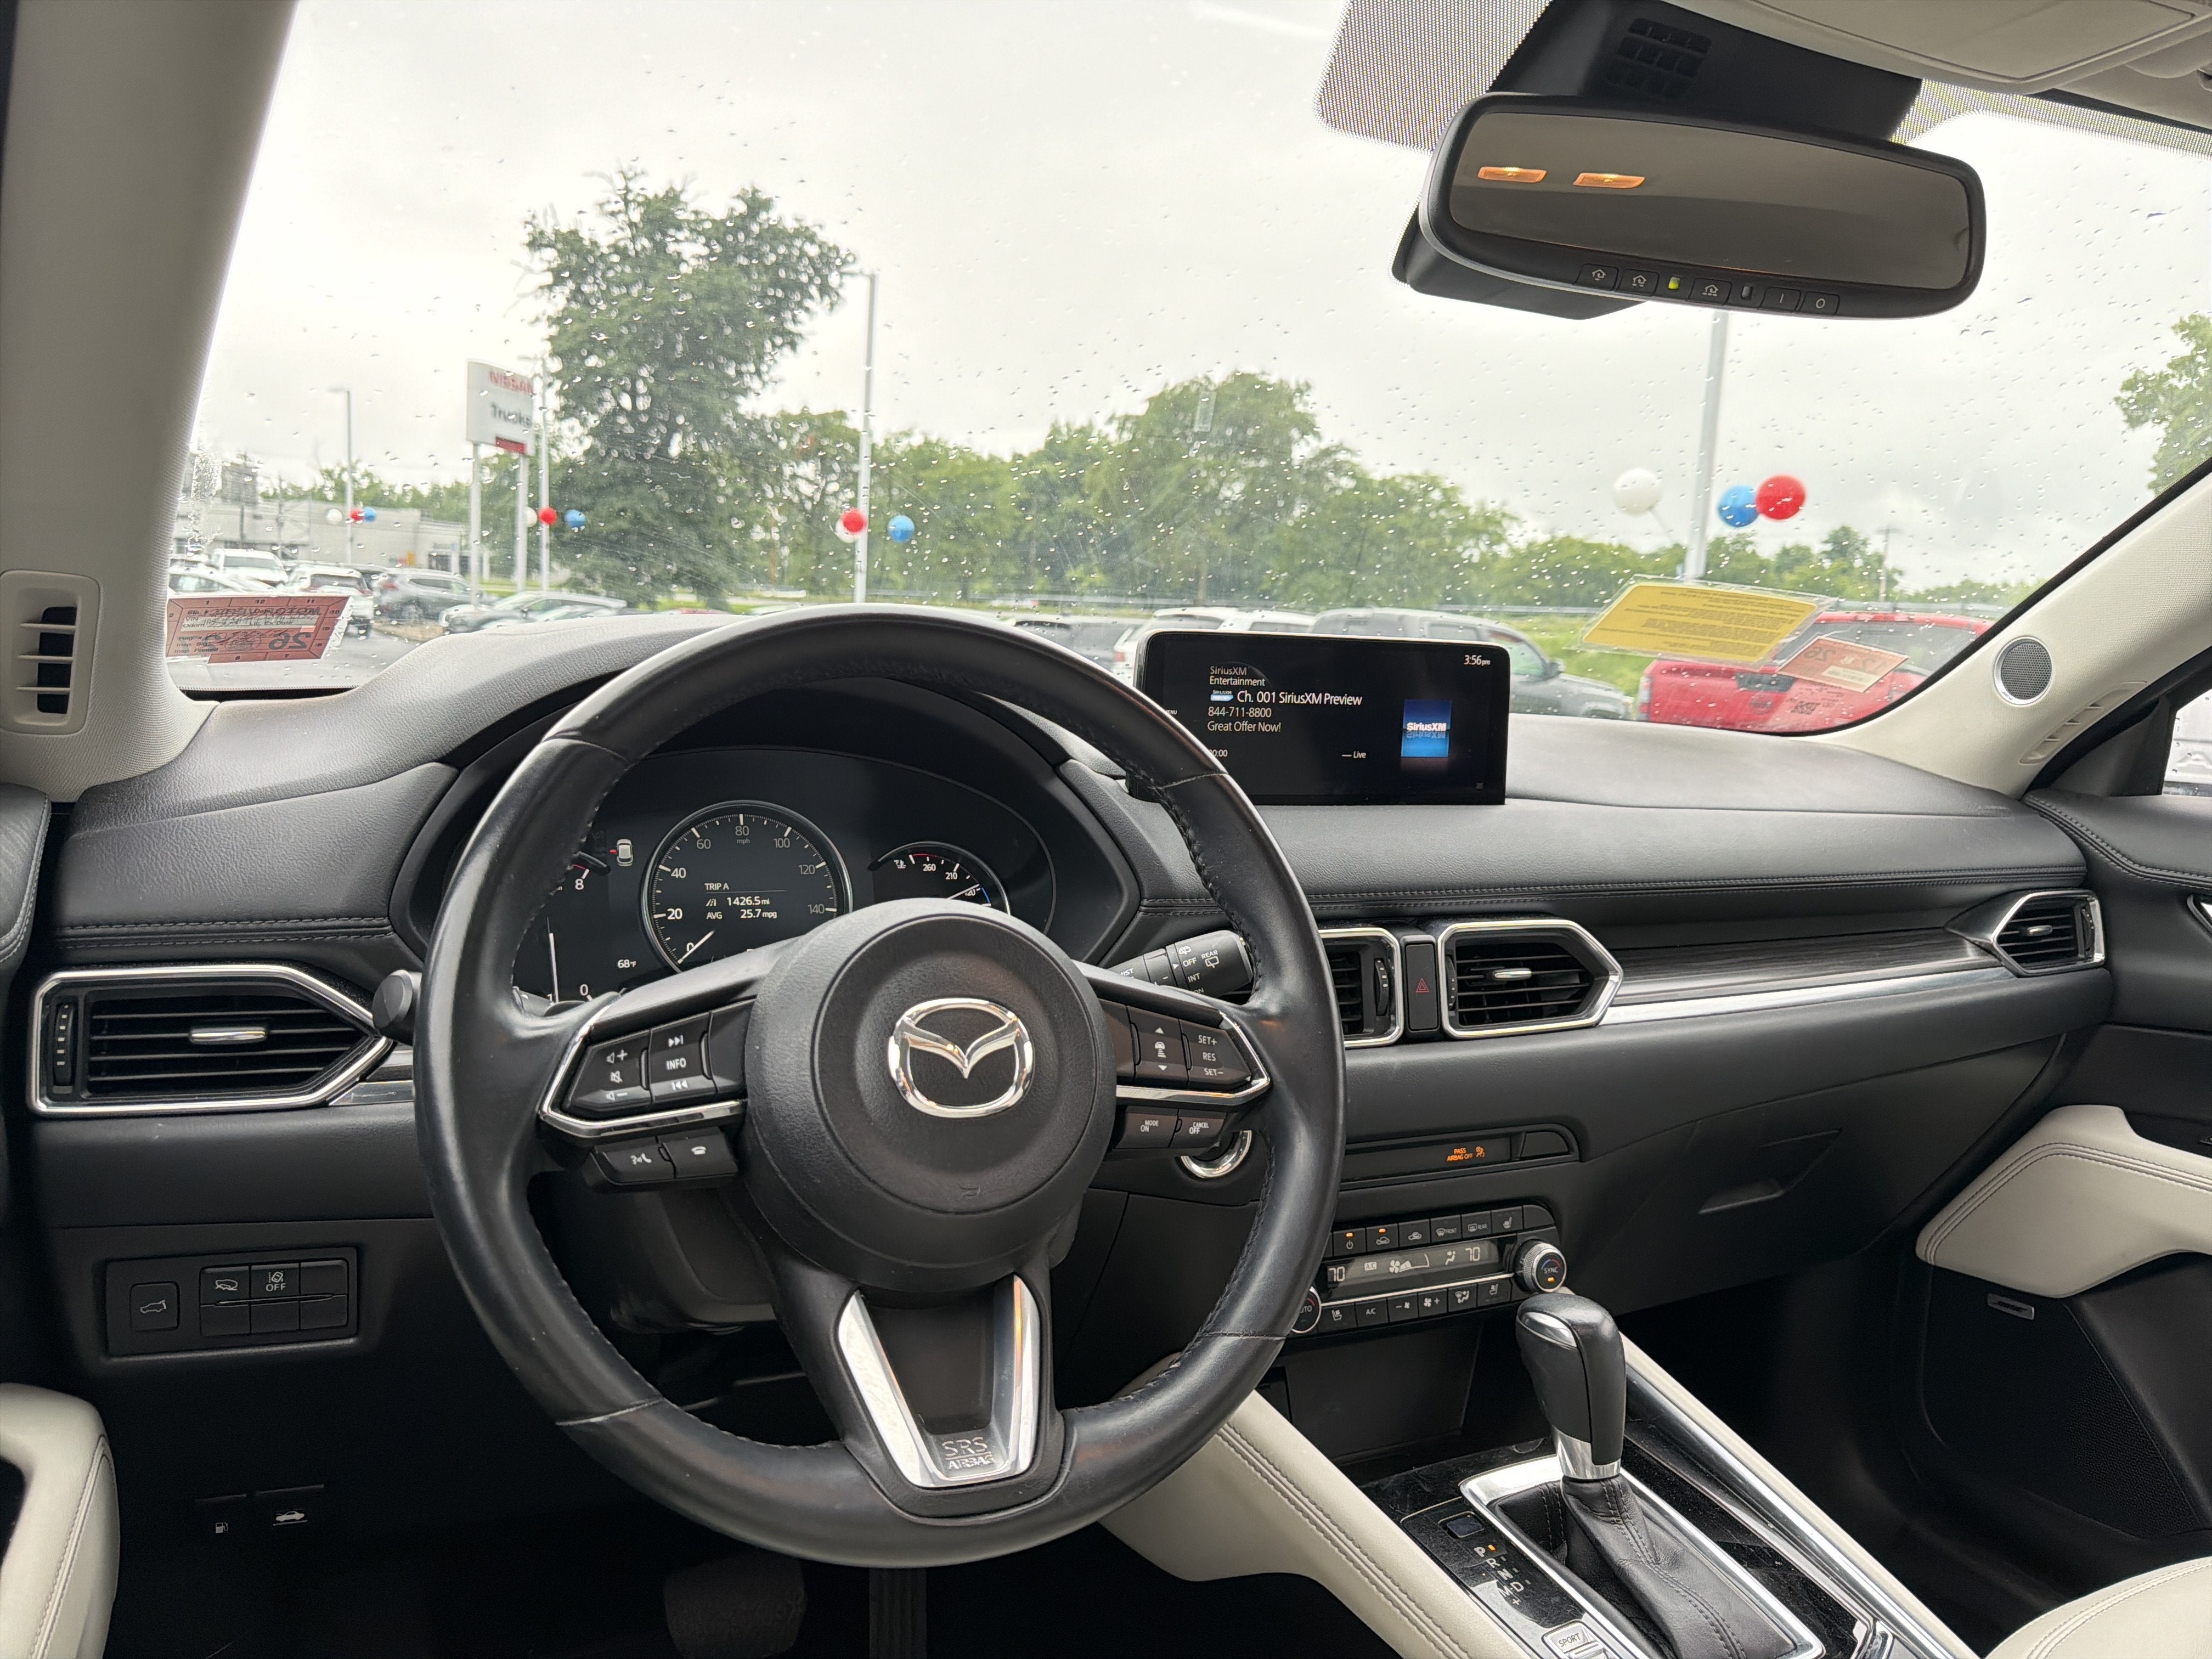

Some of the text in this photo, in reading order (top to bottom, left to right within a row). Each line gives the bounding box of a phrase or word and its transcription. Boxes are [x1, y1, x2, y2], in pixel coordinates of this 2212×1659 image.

[489, 370, 533, 395] NISSAN
[490, 402, 532, 427] Trucks
[1210, 665, 1247, 676] SiriusXM
[1209, 676, 1266, 687] Entertainment
[1237, 691, 1363, 706] Ch. 001 SiriusXM Preview
[1207, 706, 1272, 718] 844-711-8800
[1207, 720, 1281, 732] Great Offer Now!
[1406, 722, 1447, 732] SiriusXM
[735, 826, 749, 837] 80
[696, 839, 711, 849] 60
[774, 838, 791, 849] 100
[671, 867, 687, 879] 40
[798, 865, 815, 875] 120
[923, 864, 936, 872] 260
[945, 872, 958, 881] 210
[575, 878, 584, 890] 8
[704, 883, 721, 891] TRIP
[667, 909, 683, 920] 20
[706, 911, 723, 919] AVG
[808, 904, 825, 915] 140
[1201, 950, 1218, 960] REAR
[1182, 957, 1197, 967] OFF
[1187, 972, 1201, 983] INT
[580, 984, 589, 996] 0
[1198, 1035, 1217, 1045] SET+
[1203, 1052, 1216, 1062] RES
[665, 1058, 686, 1070] INFO
[1465, 1246, 1481, 1262] 70
[1328, 1266, 1345, 1283] 70
[266, 1283, 287, 1292] OFF
[1365, 1307, 1376, 1316] A/C
[941, 1436, 988, 1458] SRS
[948, 1454, 996, 1470] AIRBAG
[1474, 1546, 1486, 1558] P
[1486, 1558, 1501, 1569] R
[1497, 1568, 1514, 1581] N
[1510, 1581, 1524, 1593] D
[1558, 1633, 1581, 1647] SPORT
